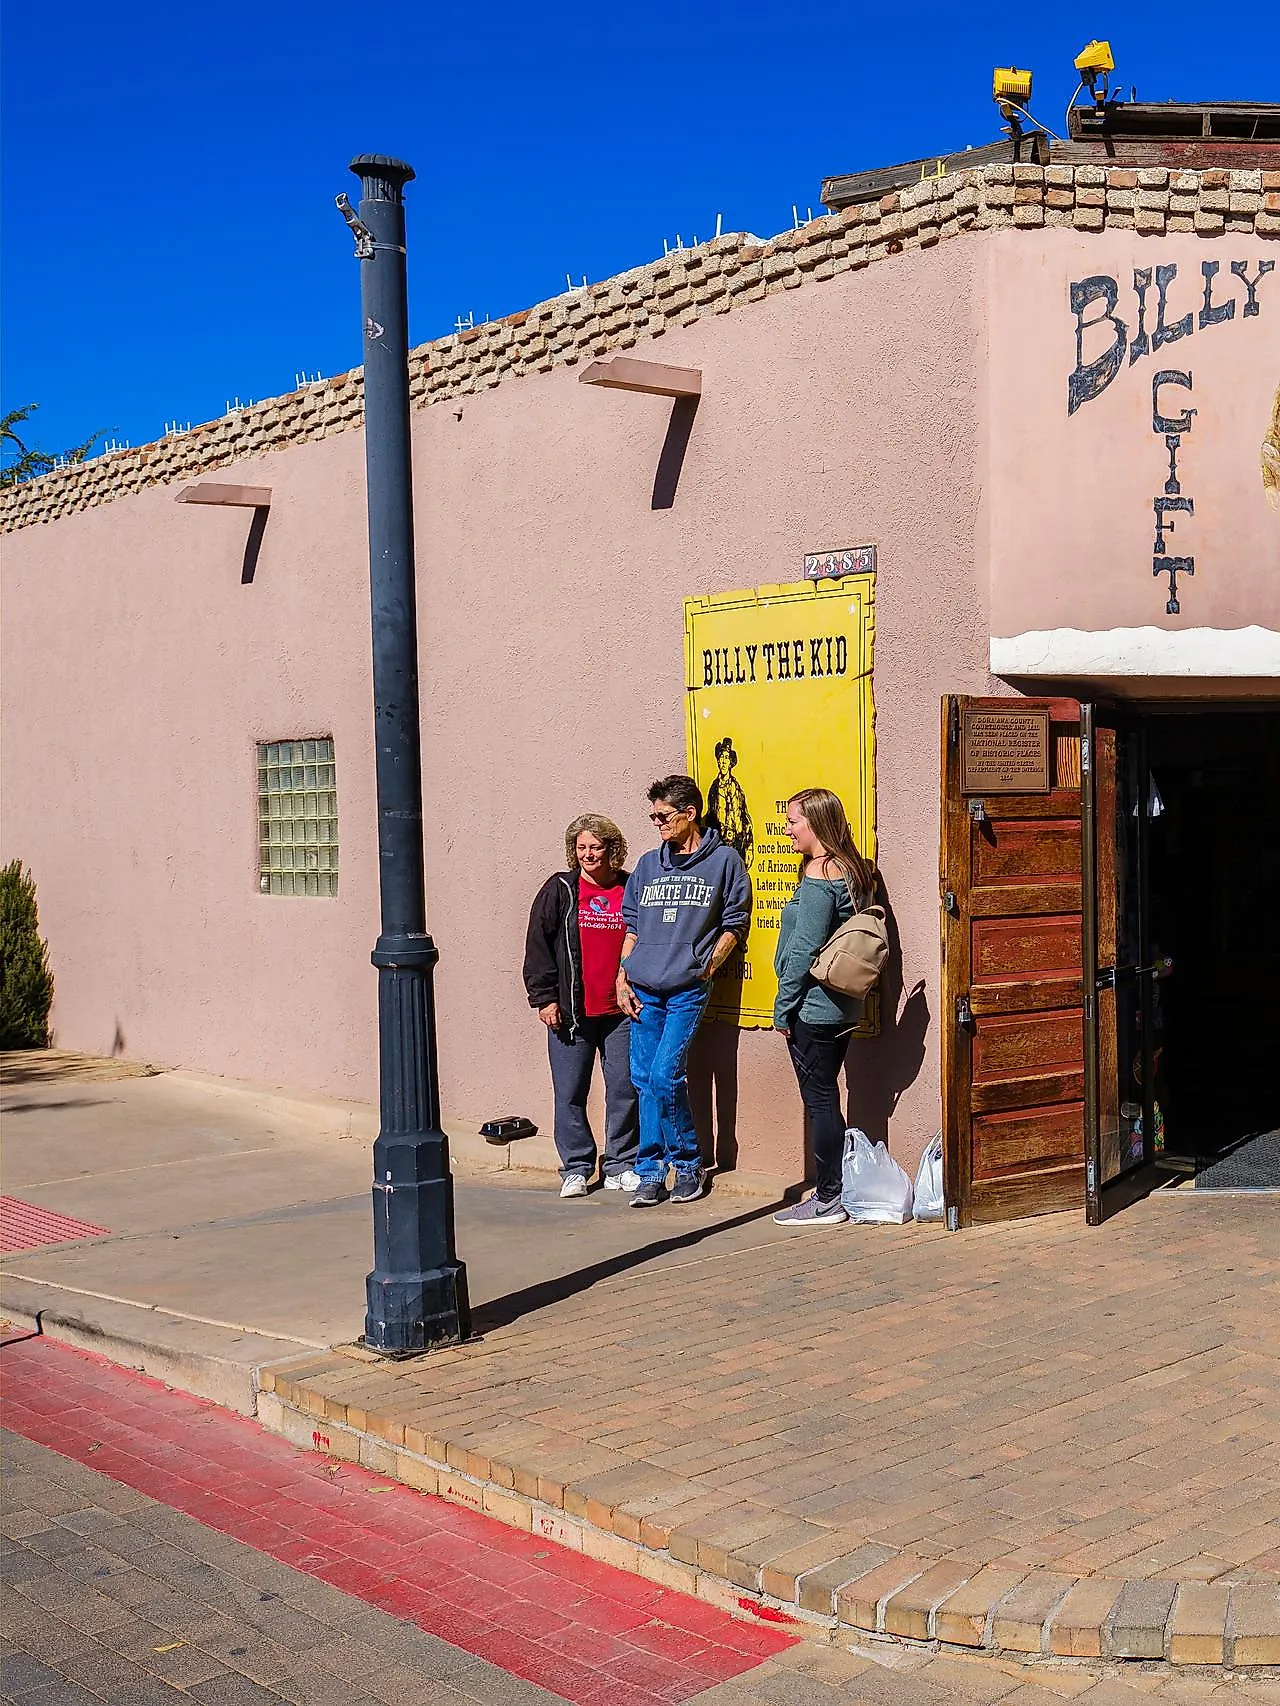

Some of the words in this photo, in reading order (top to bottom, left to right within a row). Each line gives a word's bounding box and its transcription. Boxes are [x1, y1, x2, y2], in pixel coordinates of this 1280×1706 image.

[1067, 260, 1276, 417] BILLY
[1152, 369, 1198, 614] GIFT
[807, 550, 869, 575] 2385
[702, 643, 758, 687] BILLY
[762, 640, 804, 681] THE
[809, 635, 847, 678] KID
[776, 800, 788, 813] TH
[757, 844, 775, 854] once
[777, 841, 794, 854] hous
[758, 859, 765, 873] of
[767, 859, 797, 873] Arizona
[756, 878, 776, 891] Later
[777, 878, 783, 891] it
[640, 884, 682, 907] DONATE
[685, 884, 715, 907] LIFE
[756, 896, 764, 909] in
[756, 915, 775, 929] tried
